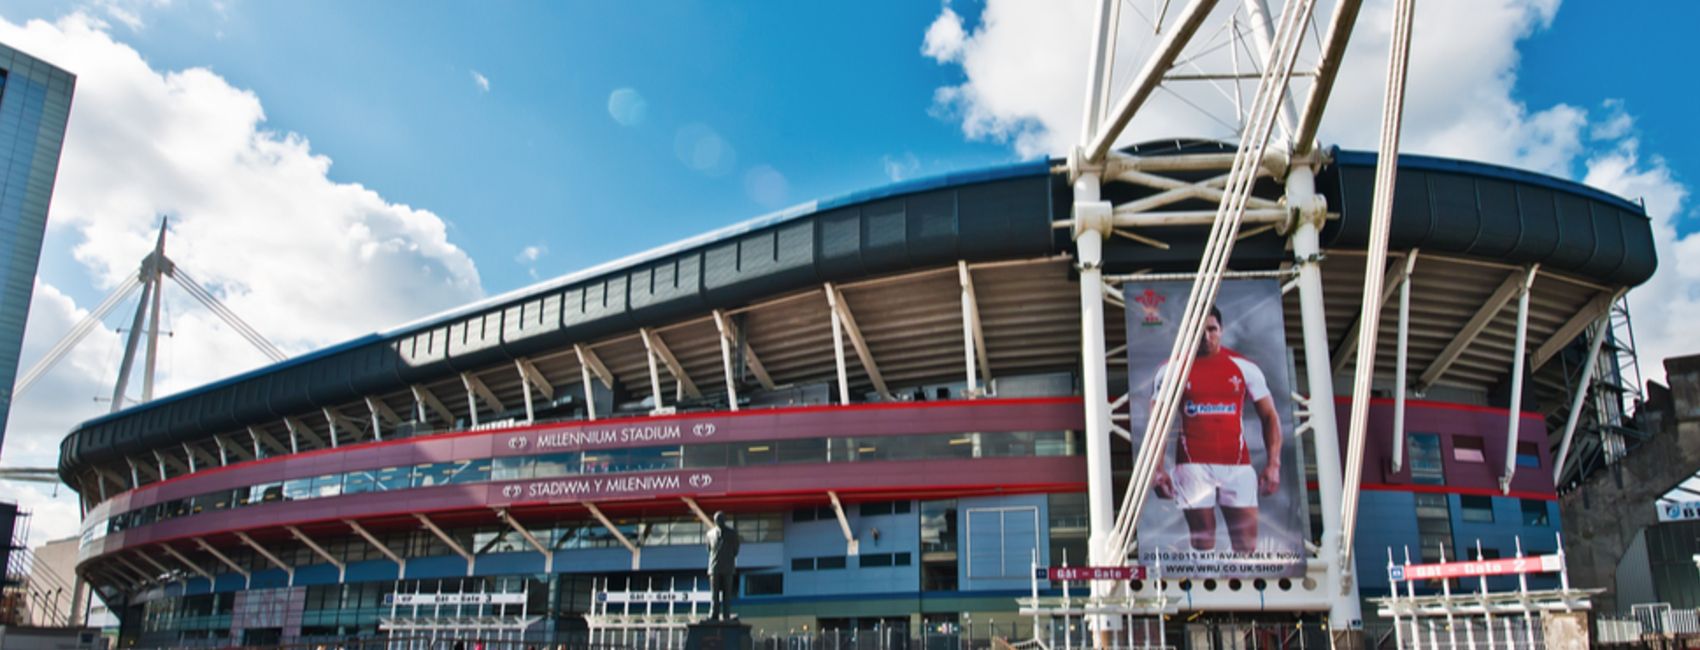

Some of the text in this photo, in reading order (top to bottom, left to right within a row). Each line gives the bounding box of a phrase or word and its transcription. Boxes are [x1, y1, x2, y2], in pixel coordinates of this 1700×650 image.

[537, 426, 681, 448] MILLENNIUM STADIUM
[529, 475, 680, 497] STADIWM Y MILENIWM
[1200, 552, 1215, 560] KIT
[1219, 552, 1272, 560] AVAILABLE
[1277, 551, 1300, 560] NOW
[1094, 567, 1122, 578] Gate
[1129, 567, 1140, 579] 2
[1464, 563, 1502, 574] Gate
[1513, 559, 1526, 572] 2
[681, 592, 689, 601] 3
